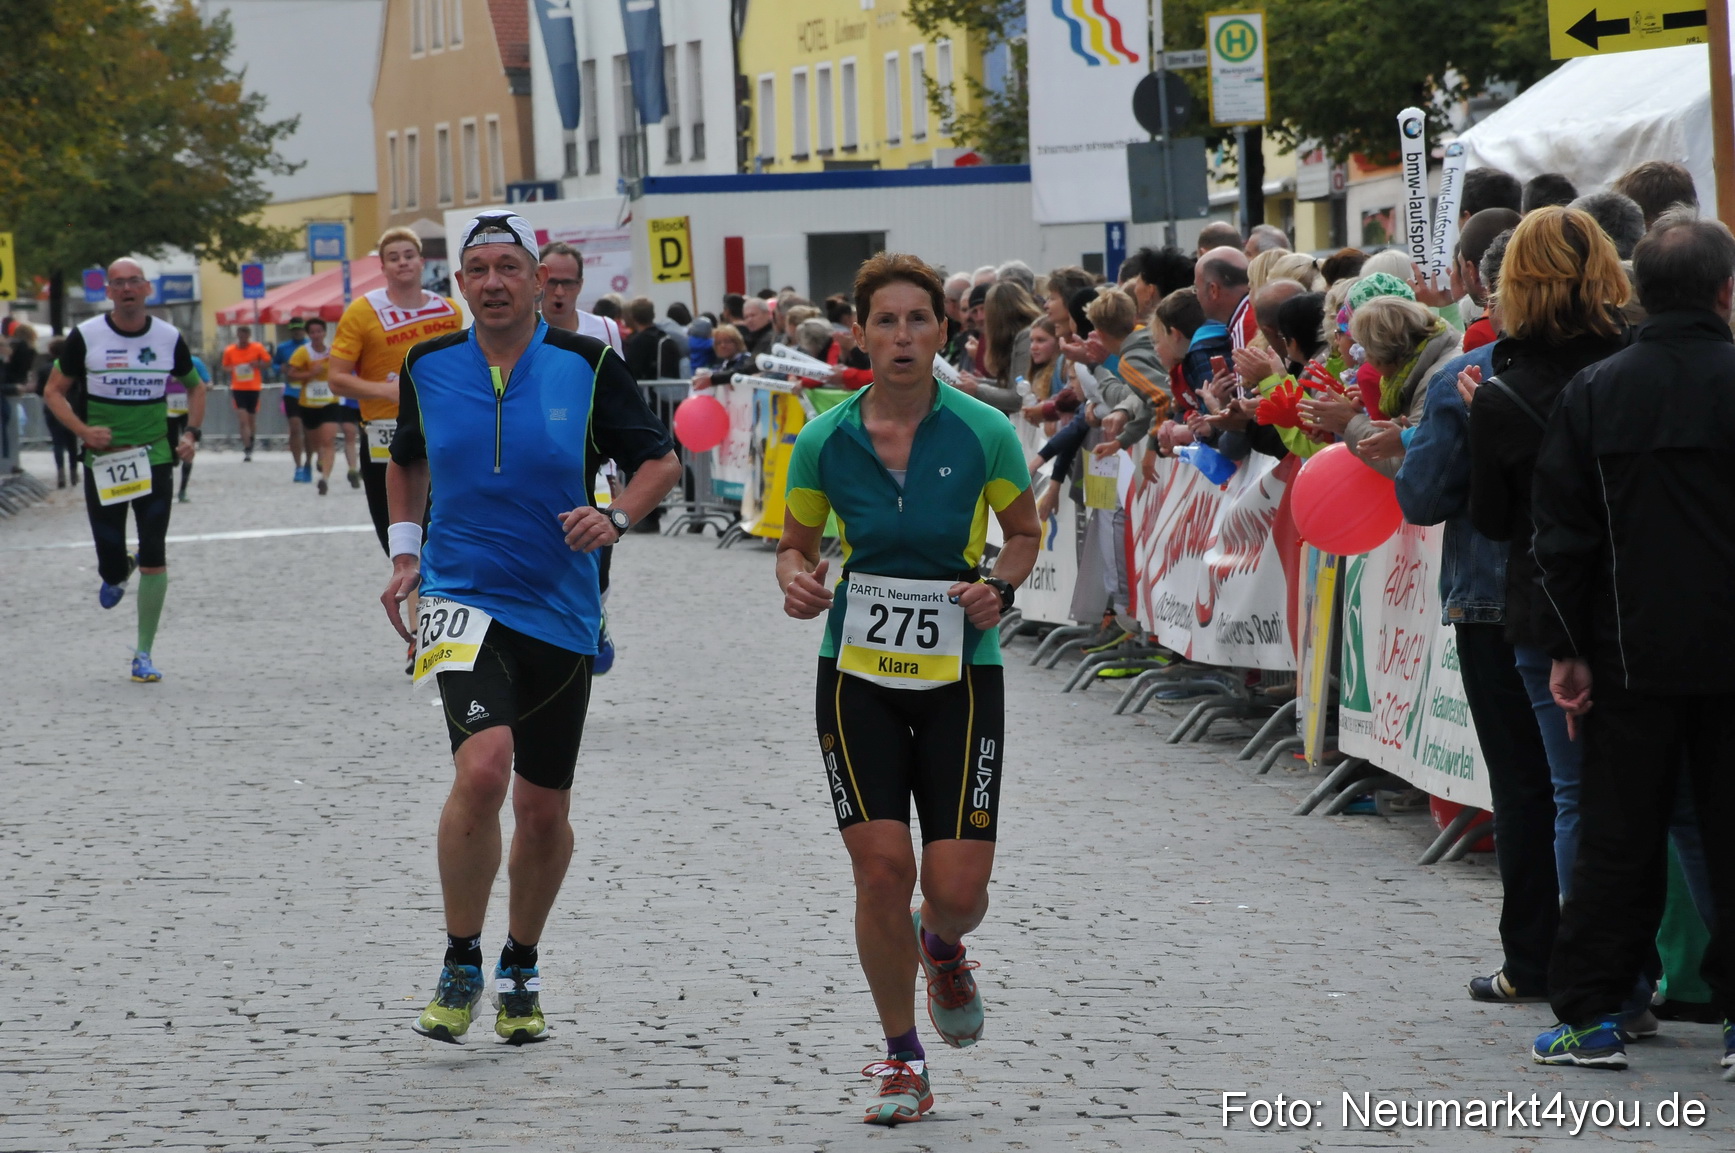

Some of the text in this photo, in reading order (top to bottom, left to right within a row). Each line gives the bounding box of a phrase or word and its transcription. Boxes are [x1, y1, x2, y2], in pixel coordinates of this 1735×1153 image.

[1226, 29, 1246, 53] H
[652, 220, 686, 233] Block
[660, 237, 683, 269] D
[386, 328, 419, 346] MAX
[102, 375, 164, 386] Laufteam
[116, 387, 151, 396] Fürth
[106, 462, 139, 484] 121
[850, 582, 944, 603] PARTL Neumarkt
[420, 607, 470, 649] 230
[866, 603, 940, 650] 275
[422, 649, 453, 673] Andreas
[878, 656, 919, 675] Klara
[466, 712, 490, 723] odlo
